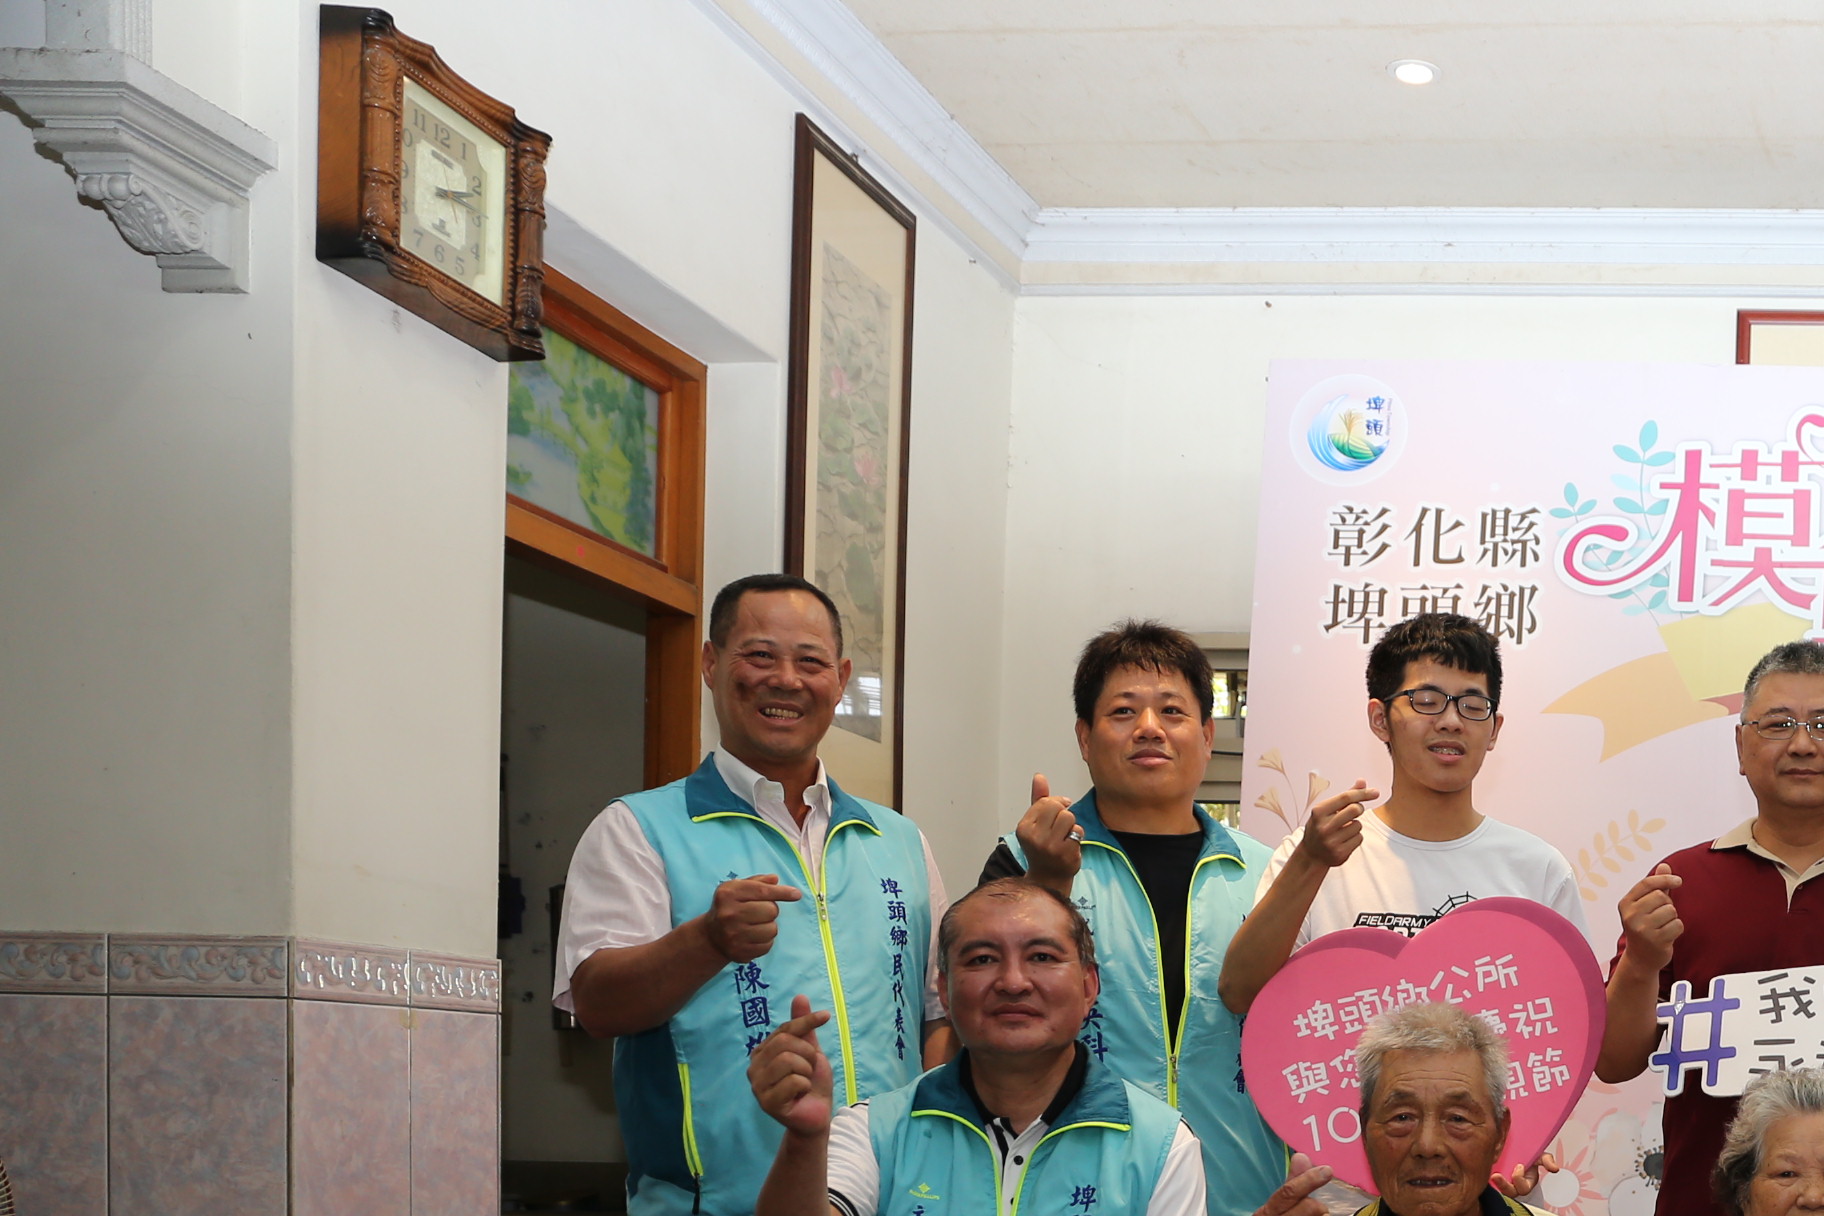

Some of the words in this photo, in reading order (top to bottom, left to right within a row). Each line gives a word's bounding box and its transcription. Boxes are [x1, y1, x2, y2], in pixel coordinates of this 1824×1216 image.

[412, 108, 427, 133] 11
[403, 127, 414, 148] 0
[433, 123, 450, 149] 12
[471, 175, 482, 197] 2
[1326, 505, 1543, 570] 彰化縣
[1358, 914, 1432, 928] FIELDARMY
[880, 877, 908, 1061] 埤頭鄉民代表會
[1292, 952, 1520, 1041] 埤頭鄉公所
